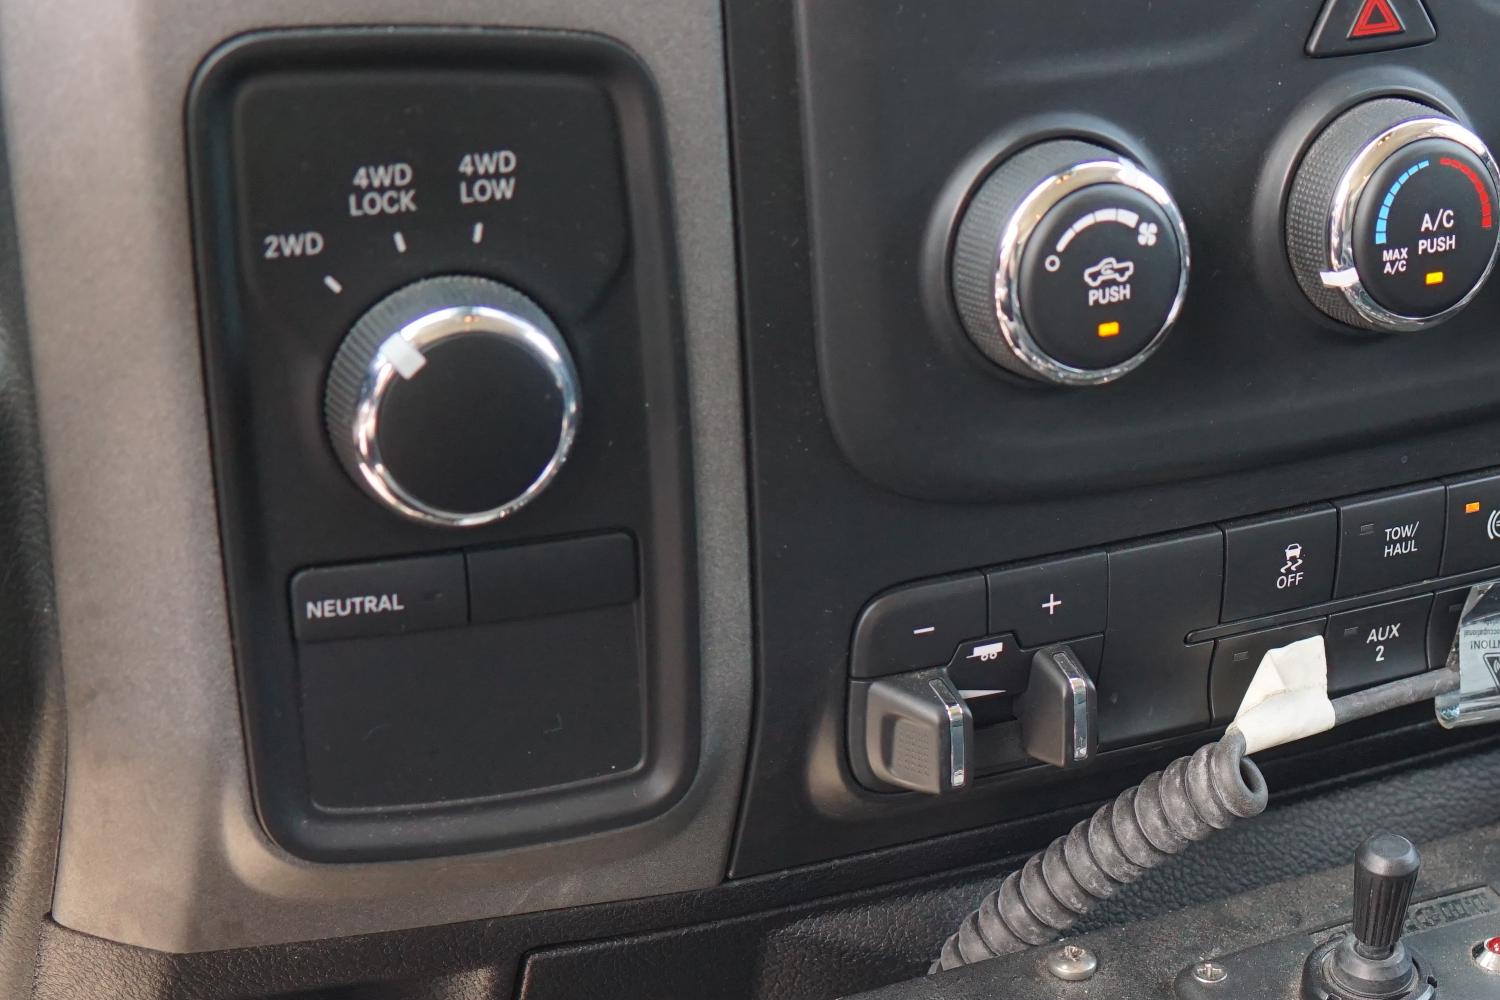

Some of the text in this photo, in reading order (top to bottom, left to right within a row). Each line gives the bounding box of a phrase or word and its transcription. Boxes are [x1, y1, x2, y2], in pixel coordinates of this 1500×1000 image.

[458, 150, 517, 176] 4WD
[353, 162, 413, 190] 4WD
[459, 177, 516, 204] LOW
[349, 189, 417, 217] LOCK
[1420, 208, 1455, 232] A/C
[264, 231, 324, 259] 2WD
[1382, 247, 1409, 262] MAX
[1418, 234, 1456, 255] PUSH
[1383, 260, 1407, 275] A/C
[1088, 283, 1131, 307] PUSH
[1384, 521, 1421, 542] TOW/
[1383, 539, 1419, 558] HAUL
[1276, 572, 1304, 589] OFF
[306, 593, 405, 619] NEUTRAL
[1366, 623, 1401, 644] AUX
[1375, 645, 1385, 662] 2
